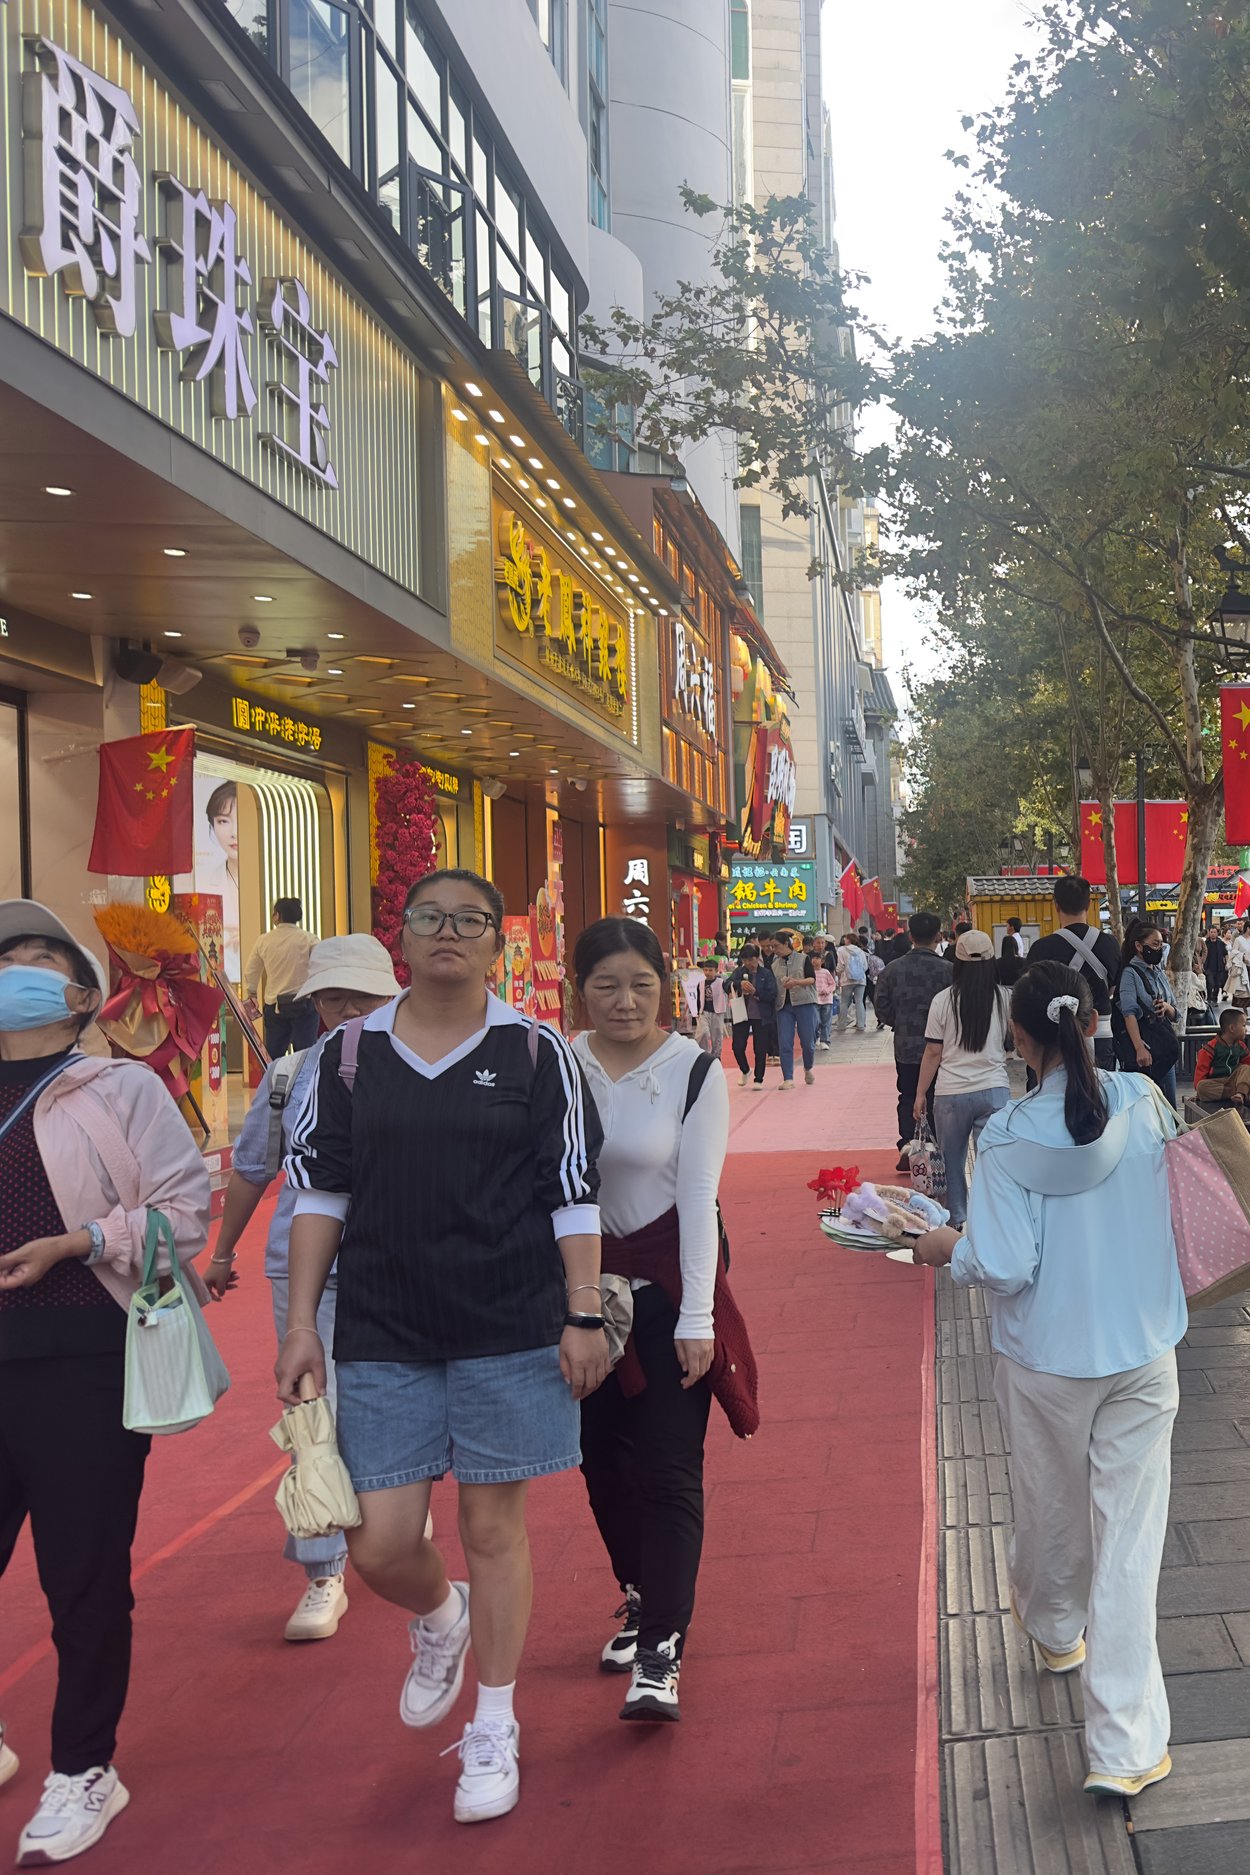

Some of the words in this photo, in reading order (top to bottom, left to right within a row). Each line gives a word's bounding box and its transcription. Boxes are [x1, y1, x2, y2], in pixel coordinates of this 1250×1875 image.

[24, 34, 340, 490] 爵珠宝
[623, 859, 650, 925] 周六
[730, 878, 808, 903] 锅牛肉
[774, 902, 798, 910] Shrimp
[472, 1079, 495, 1087] adidas
